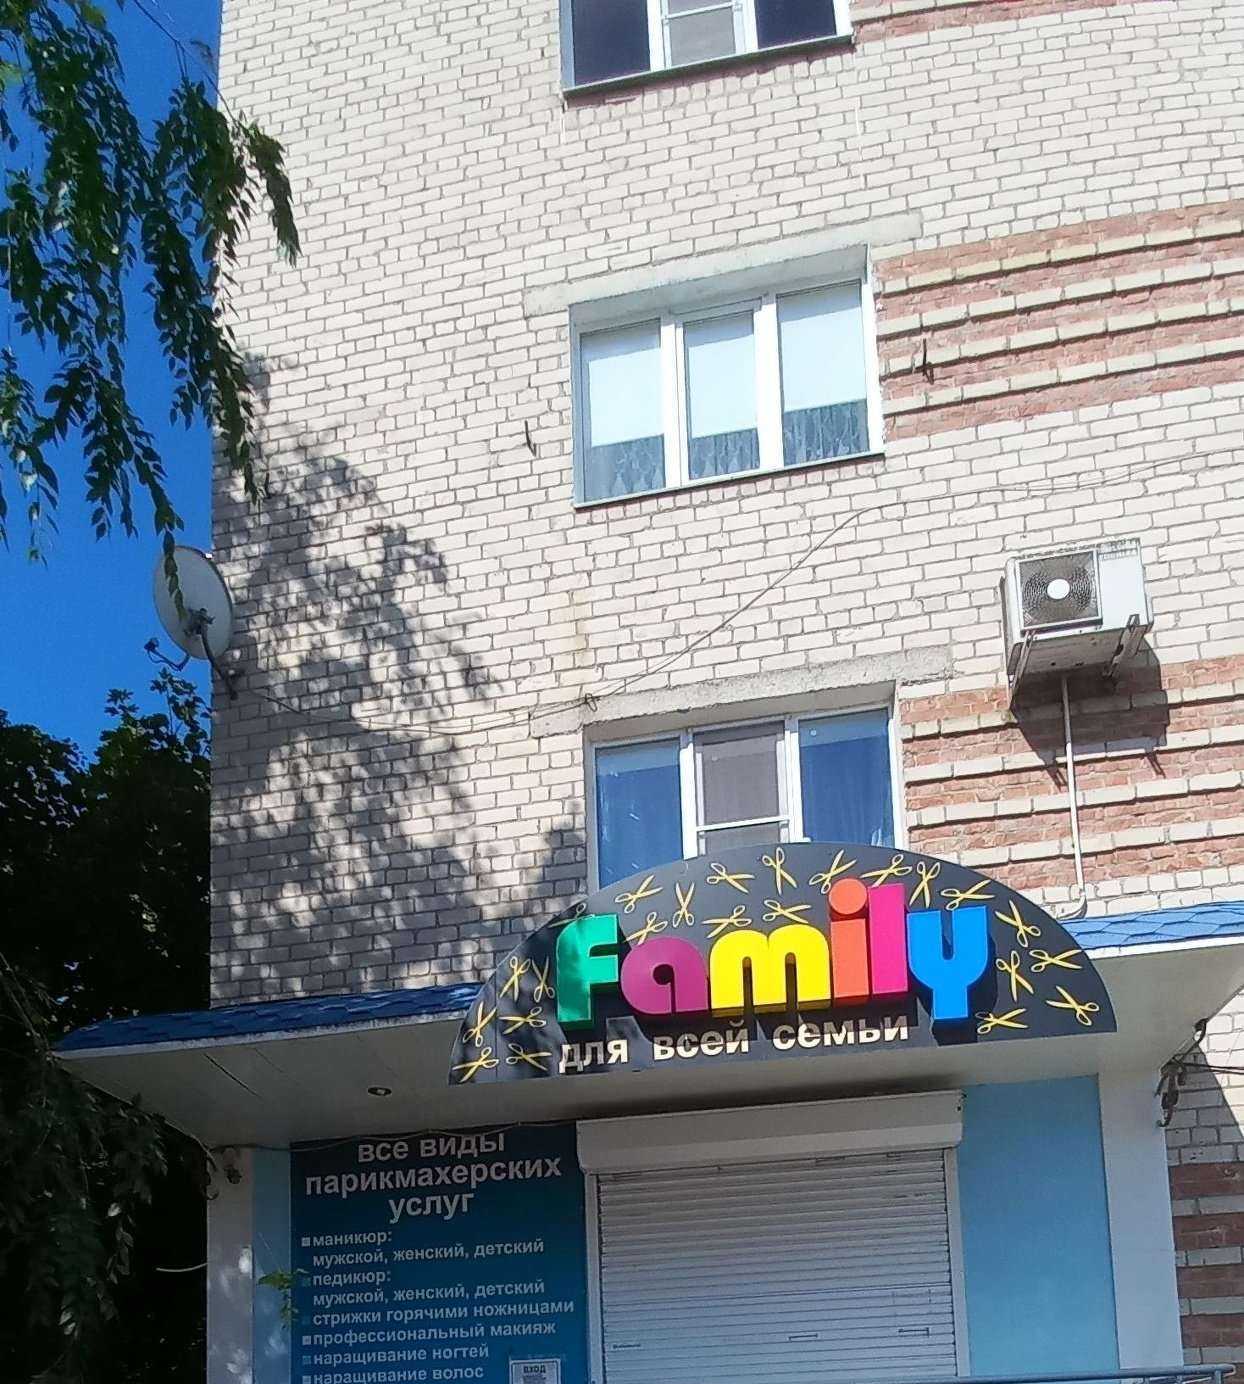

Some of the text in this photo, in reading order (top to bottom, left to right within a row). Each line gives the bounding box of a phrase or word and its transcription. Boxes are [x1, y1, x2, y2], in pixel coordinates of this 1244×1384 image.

[556, 878, 990, 1022] family
[558, 1015, 910, 1073] для всей семьи
[358, 1133, 505, 1163] все виды
[305, 1157, 562, 1198] парикмахерских
[388, 1192, 475, 1224] услуг
[313, 1230, 392, 1247] маникюр:
[313, 1238, 545, 1268] мужской, женский, детский
[313, 1269, 391, 1287] педикюр:
[313, 1279, 545, 1308] мужской, женский, детский
[313, 1300, 574, 1326] стрижки горячими ножницами
[313, 1322, 556, 1347] профессиональный макияж
[313, 1343, 489, 1369] наращивание ногтей
[432, 1366, 484, 1380] волос
